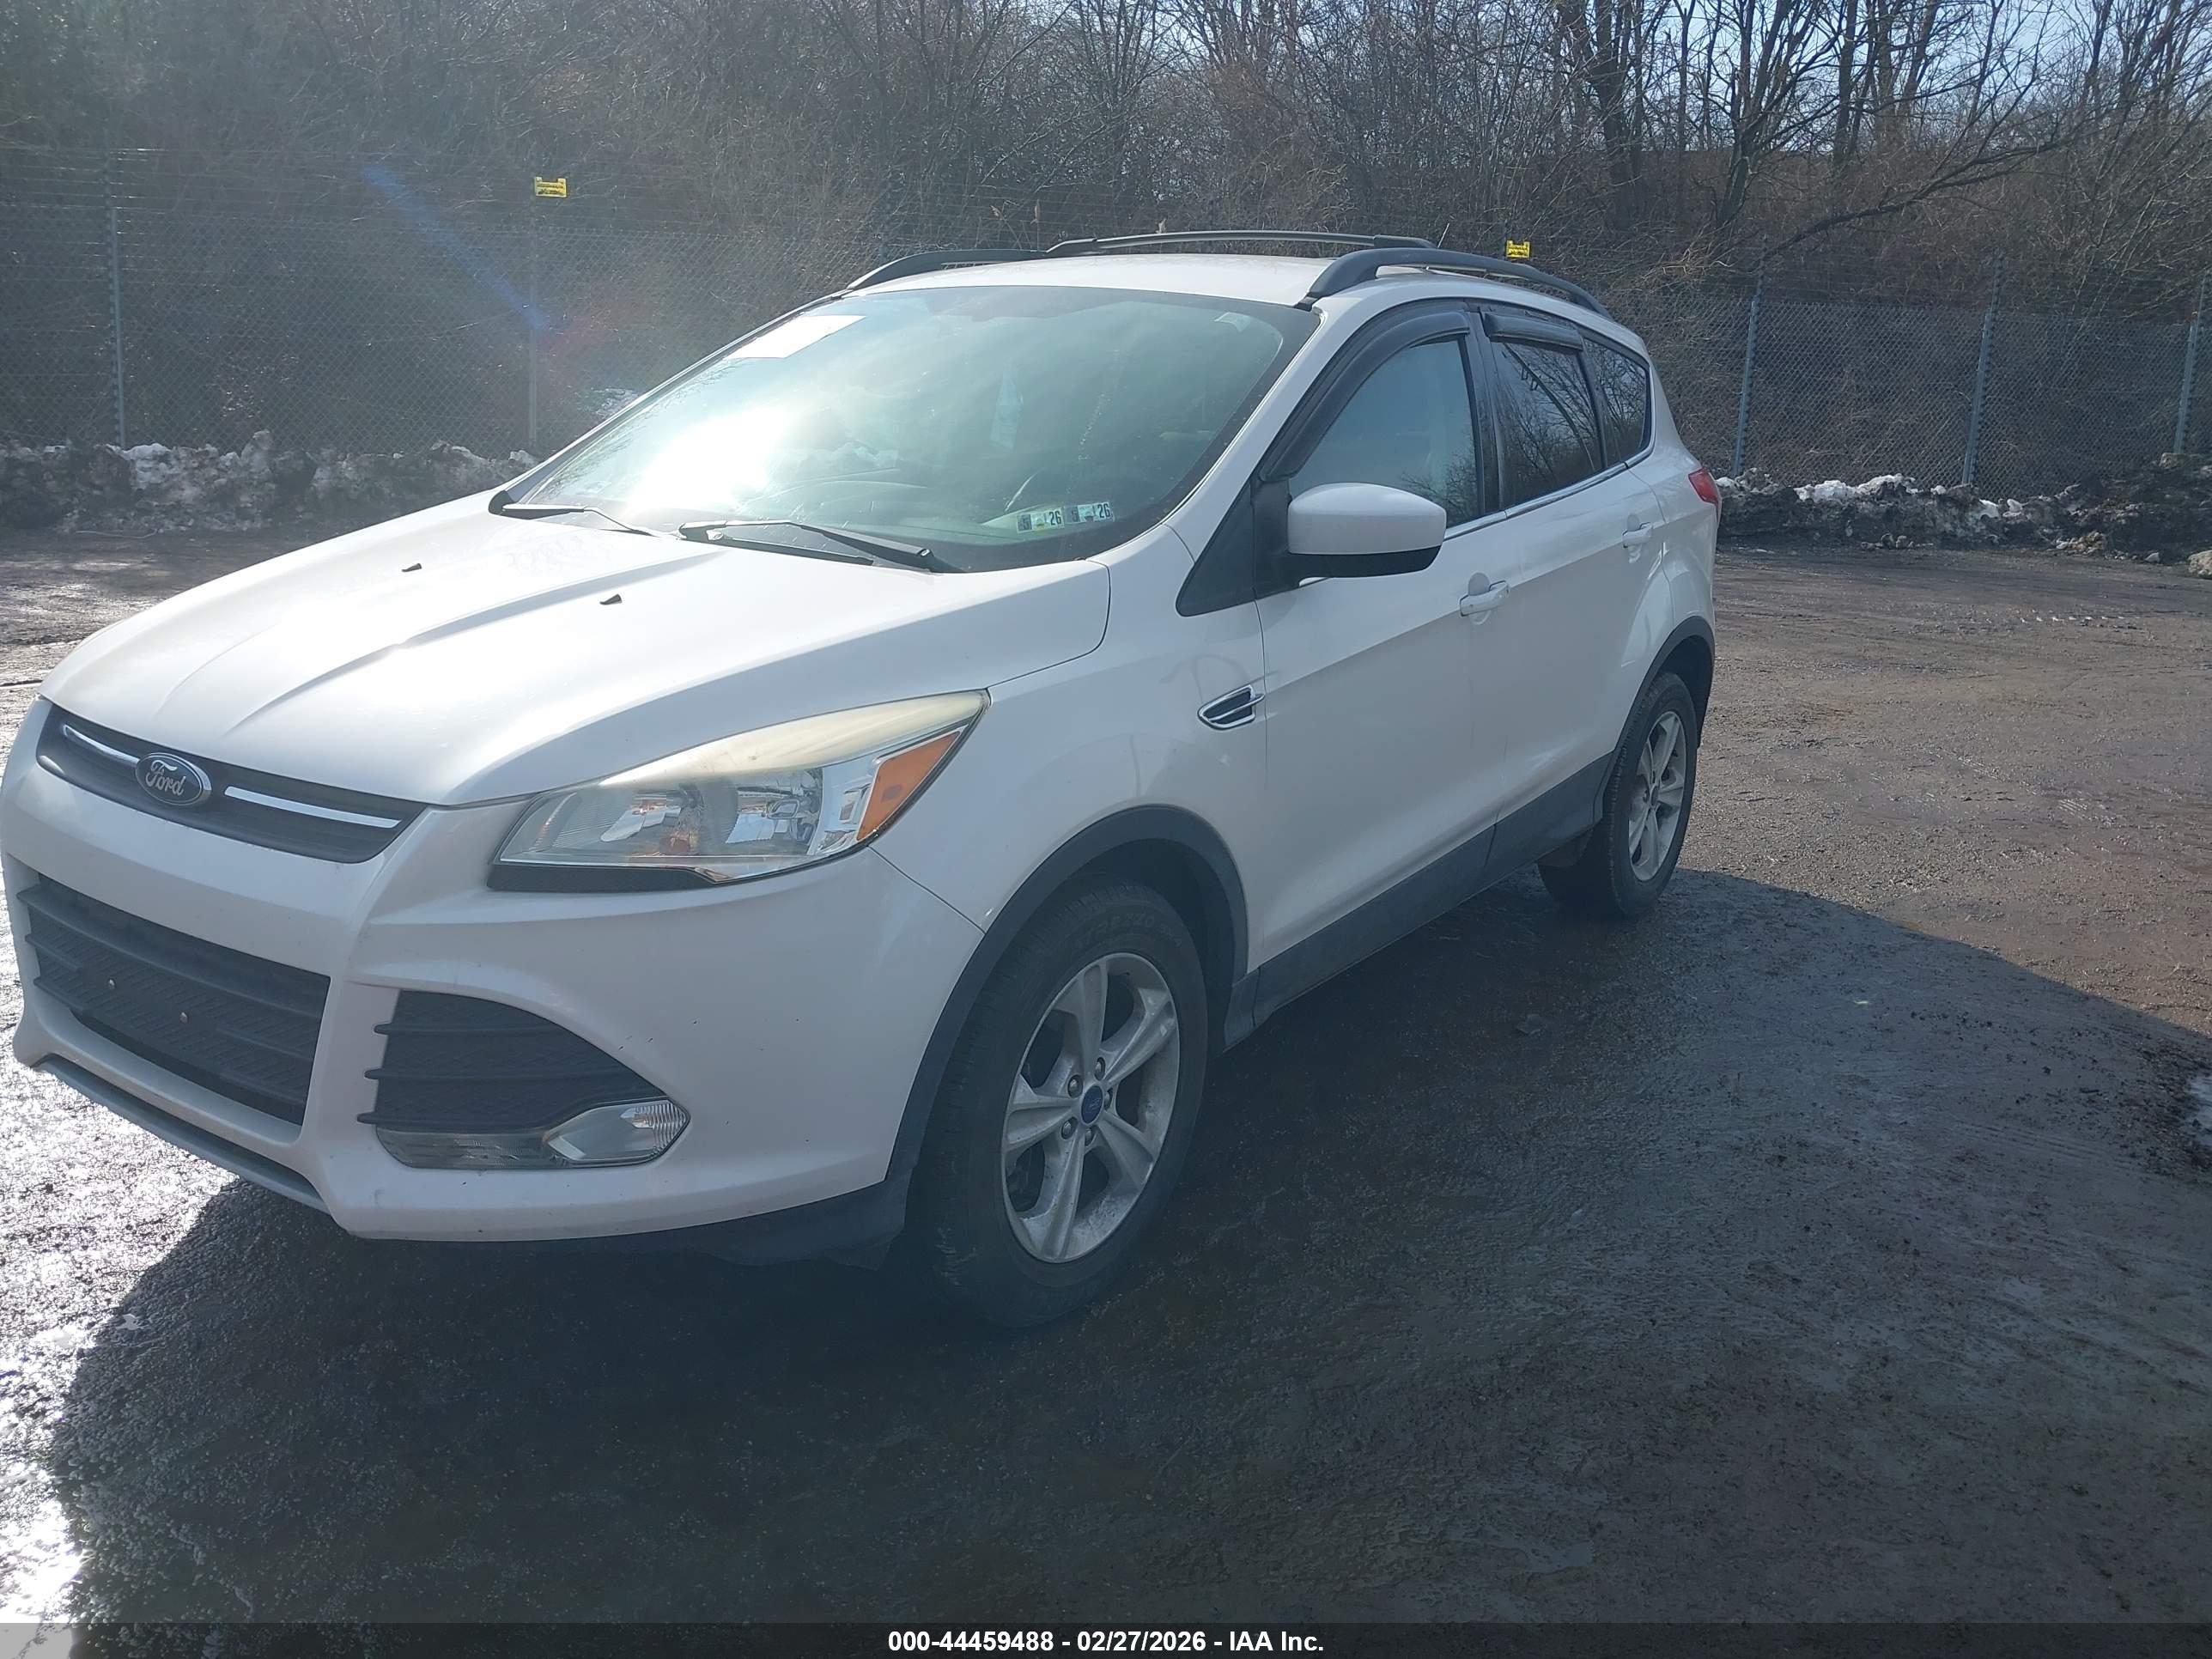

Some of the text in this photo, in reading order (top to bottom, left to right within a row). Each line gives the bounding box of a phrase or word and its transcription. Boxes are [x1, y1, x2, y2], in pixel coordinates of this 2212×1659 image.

[1048, 510, 1062, 526] 26
[1097, 503, 1111, 519] 26
[144, 759, 187, 796] Ford
